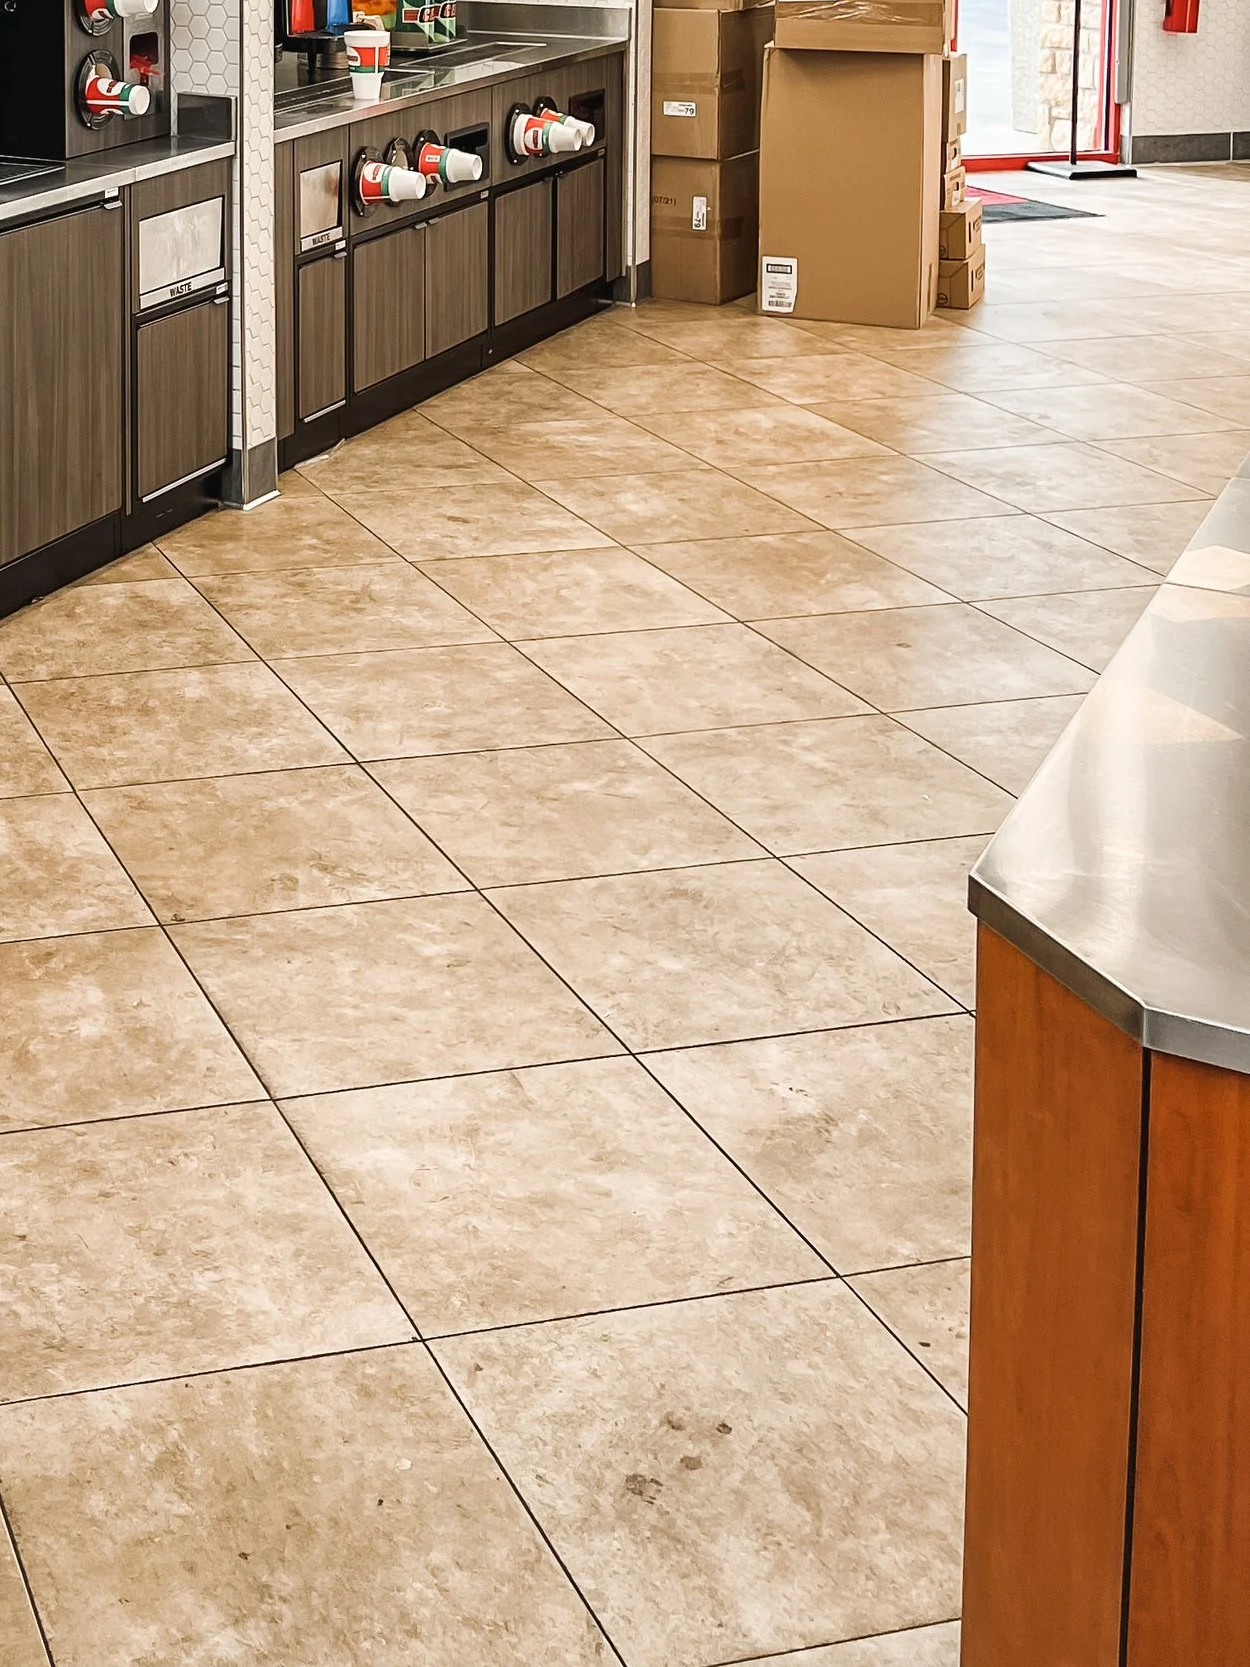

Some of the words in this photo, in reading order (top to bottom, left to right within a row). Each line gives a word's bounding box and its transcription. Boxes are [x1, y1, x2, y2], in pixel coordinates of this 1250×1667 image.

[684, 107, 694, 115] 79
[694, 218, 701, 228] 79
[170, 281, 191, 297] WASTE
